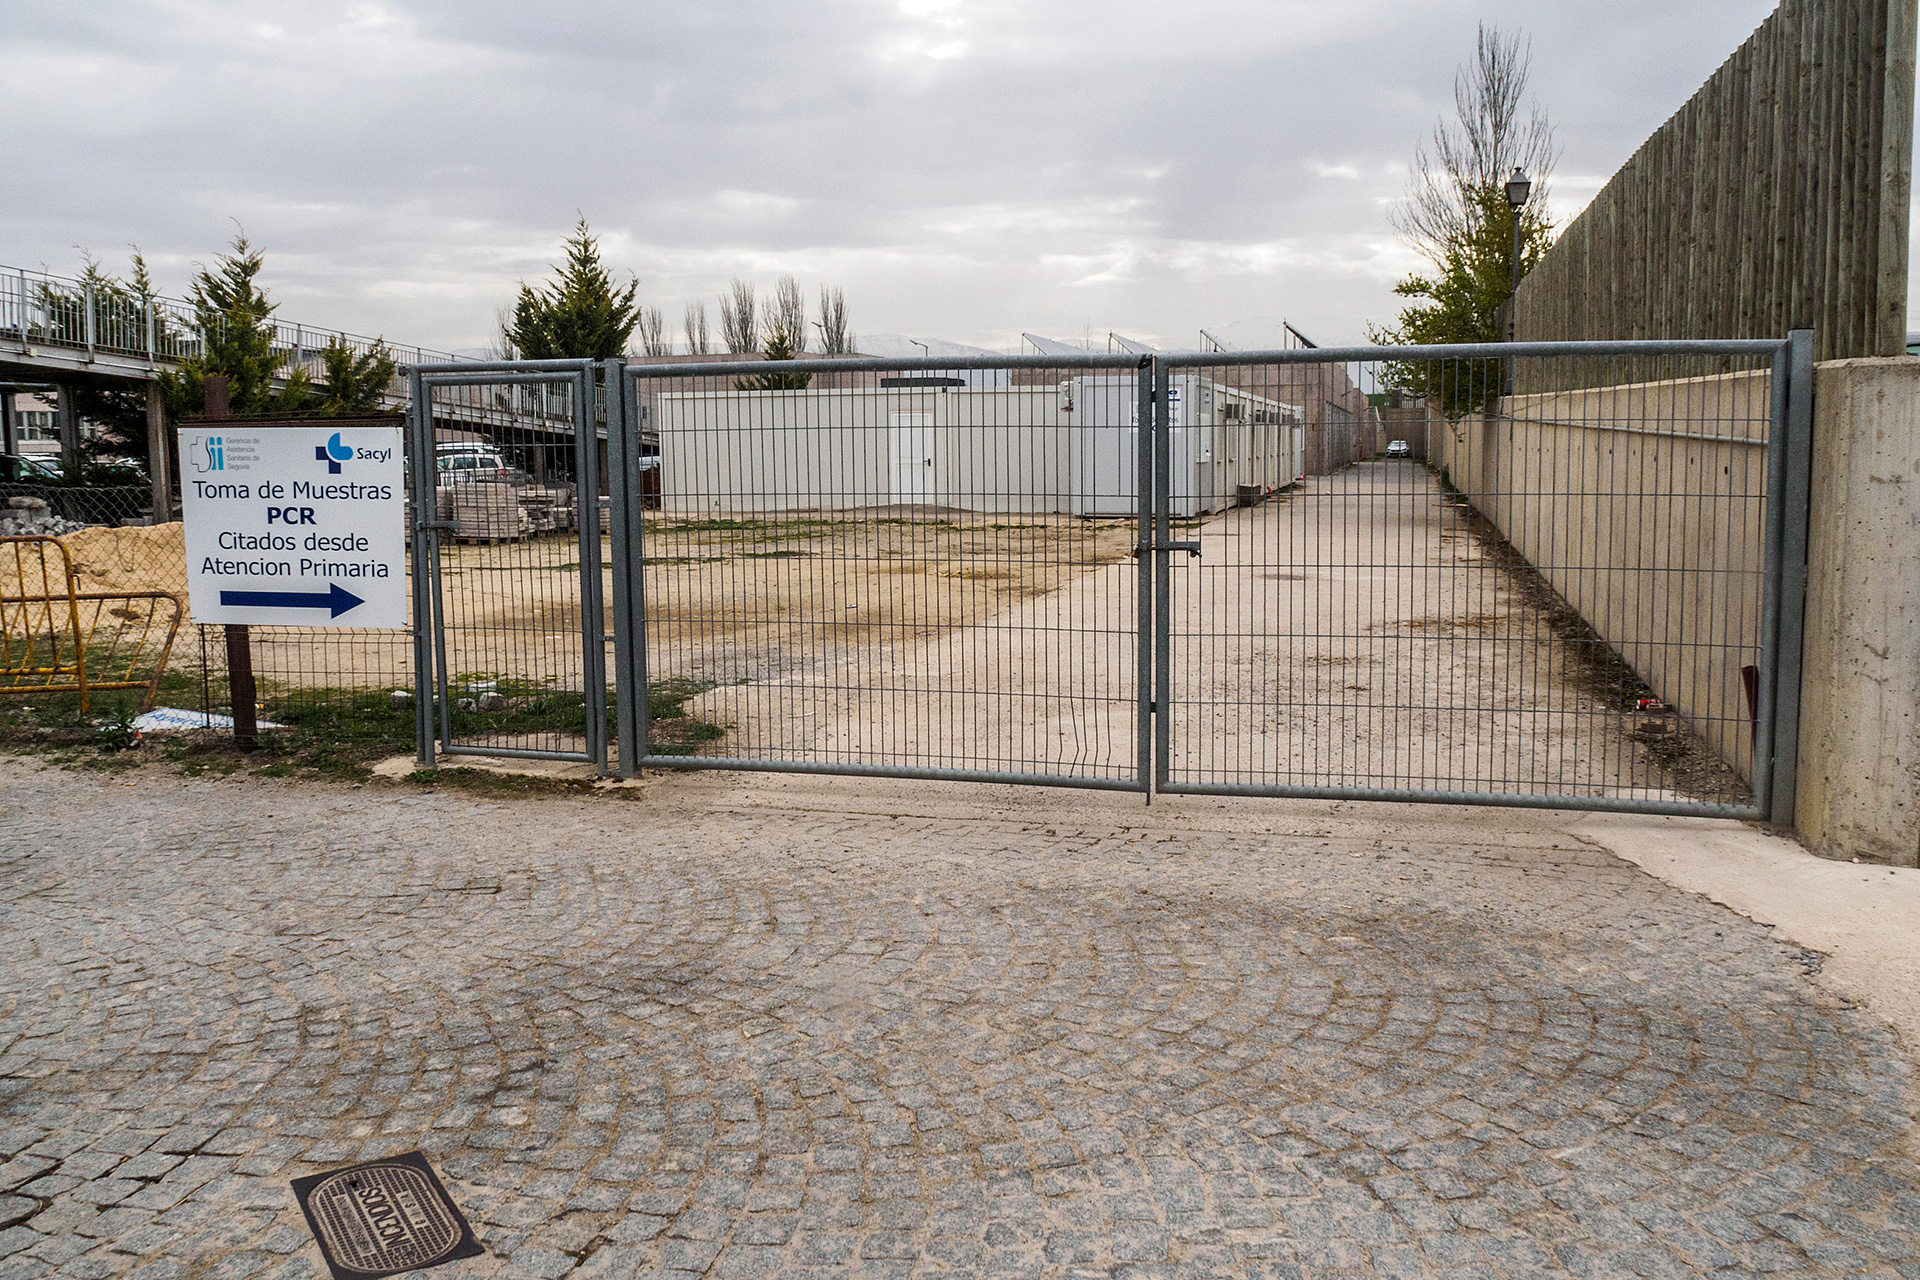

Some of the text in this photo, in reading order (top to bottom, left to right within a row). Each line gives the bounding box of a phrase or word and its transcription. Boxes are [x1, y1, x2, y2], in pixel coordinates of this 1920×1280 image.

[252, 437, 260, 445] de
[356, 447, 392, 463] Sacyl
[192, 480, 392, 500] Toma de Muestras
[267, 506, 317, 525] PCR
[218, 531, 369, 552] Citados desde
[201, 556, 389, 578] Atencion Primaria
[358, 1187, 413, 1250] INCENDIOS
